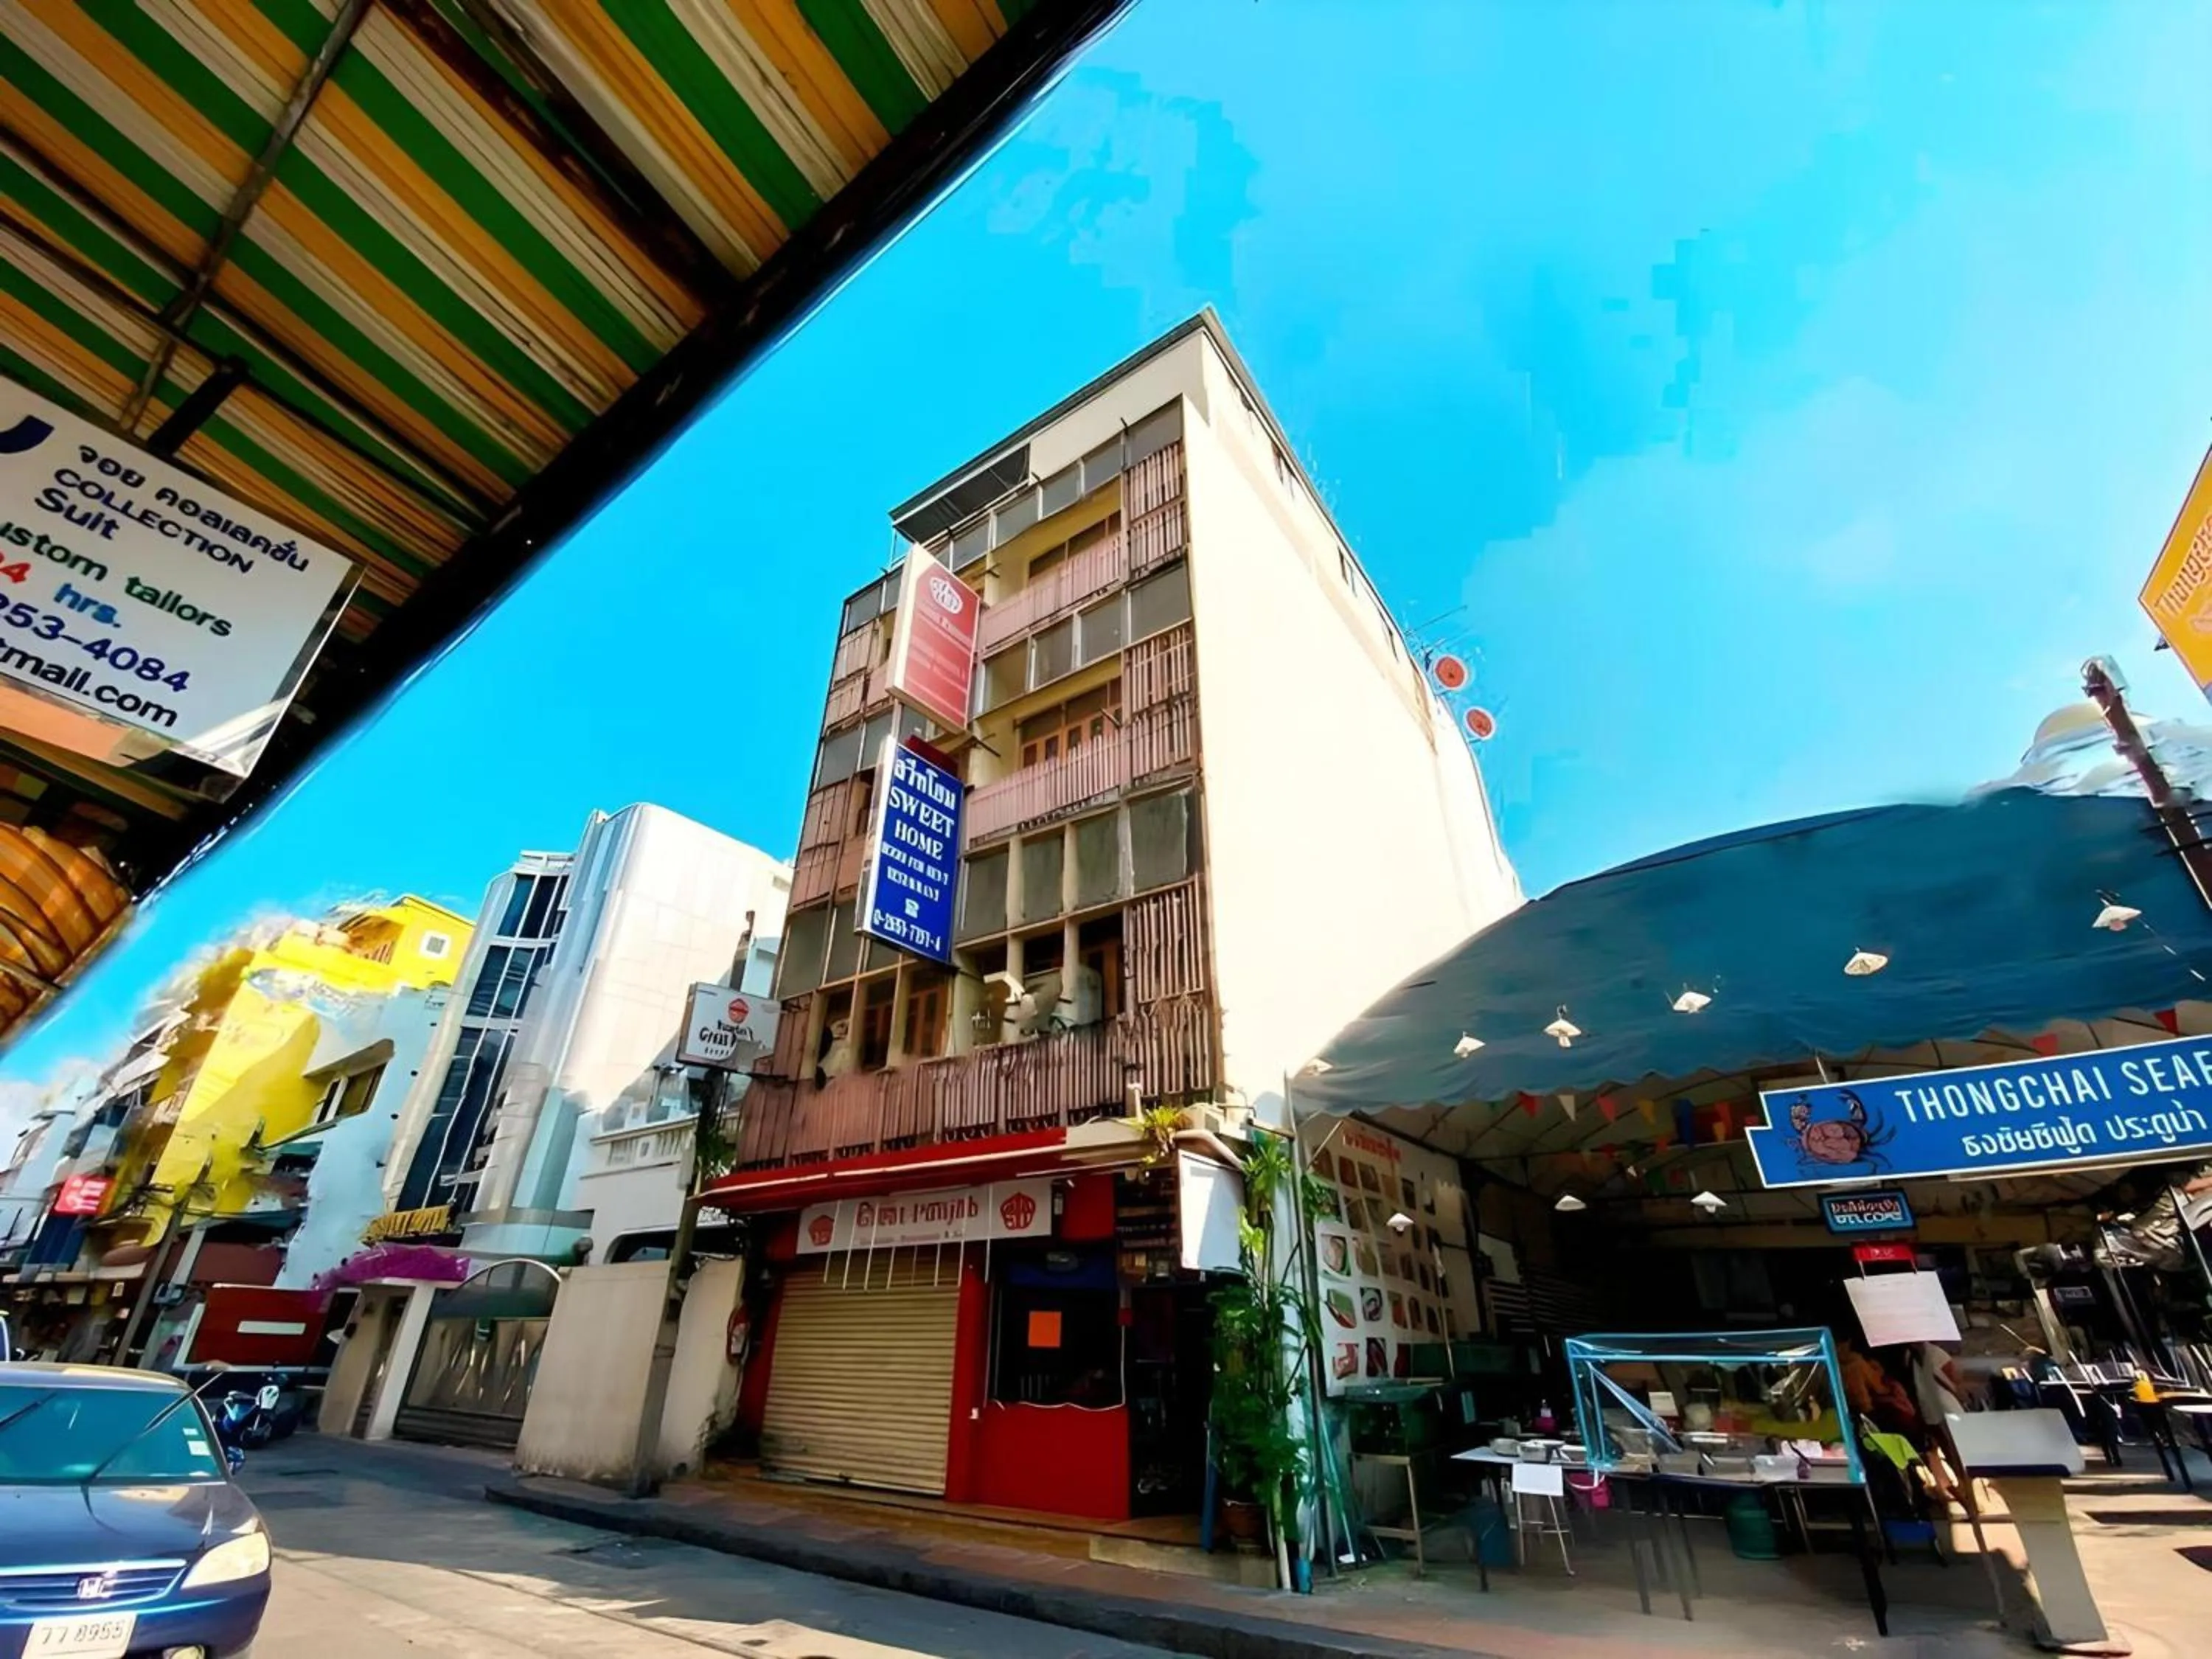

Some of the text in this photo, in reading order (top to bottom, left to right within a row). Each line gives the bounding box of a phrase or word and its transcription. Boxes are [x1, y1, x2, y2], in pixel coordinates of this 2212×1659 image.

[35, 487, 119, 540] Suit
[54, 468, 254, 574] COLLECTION
[0, 551, 31, 582] 4
[125, 577, 232, 636] tailors
[888, 786, 955, 838] SWEET
[894, 819, 944, 860] HOME
[1893, 1066, 2112, 1123] THONGCHAI
